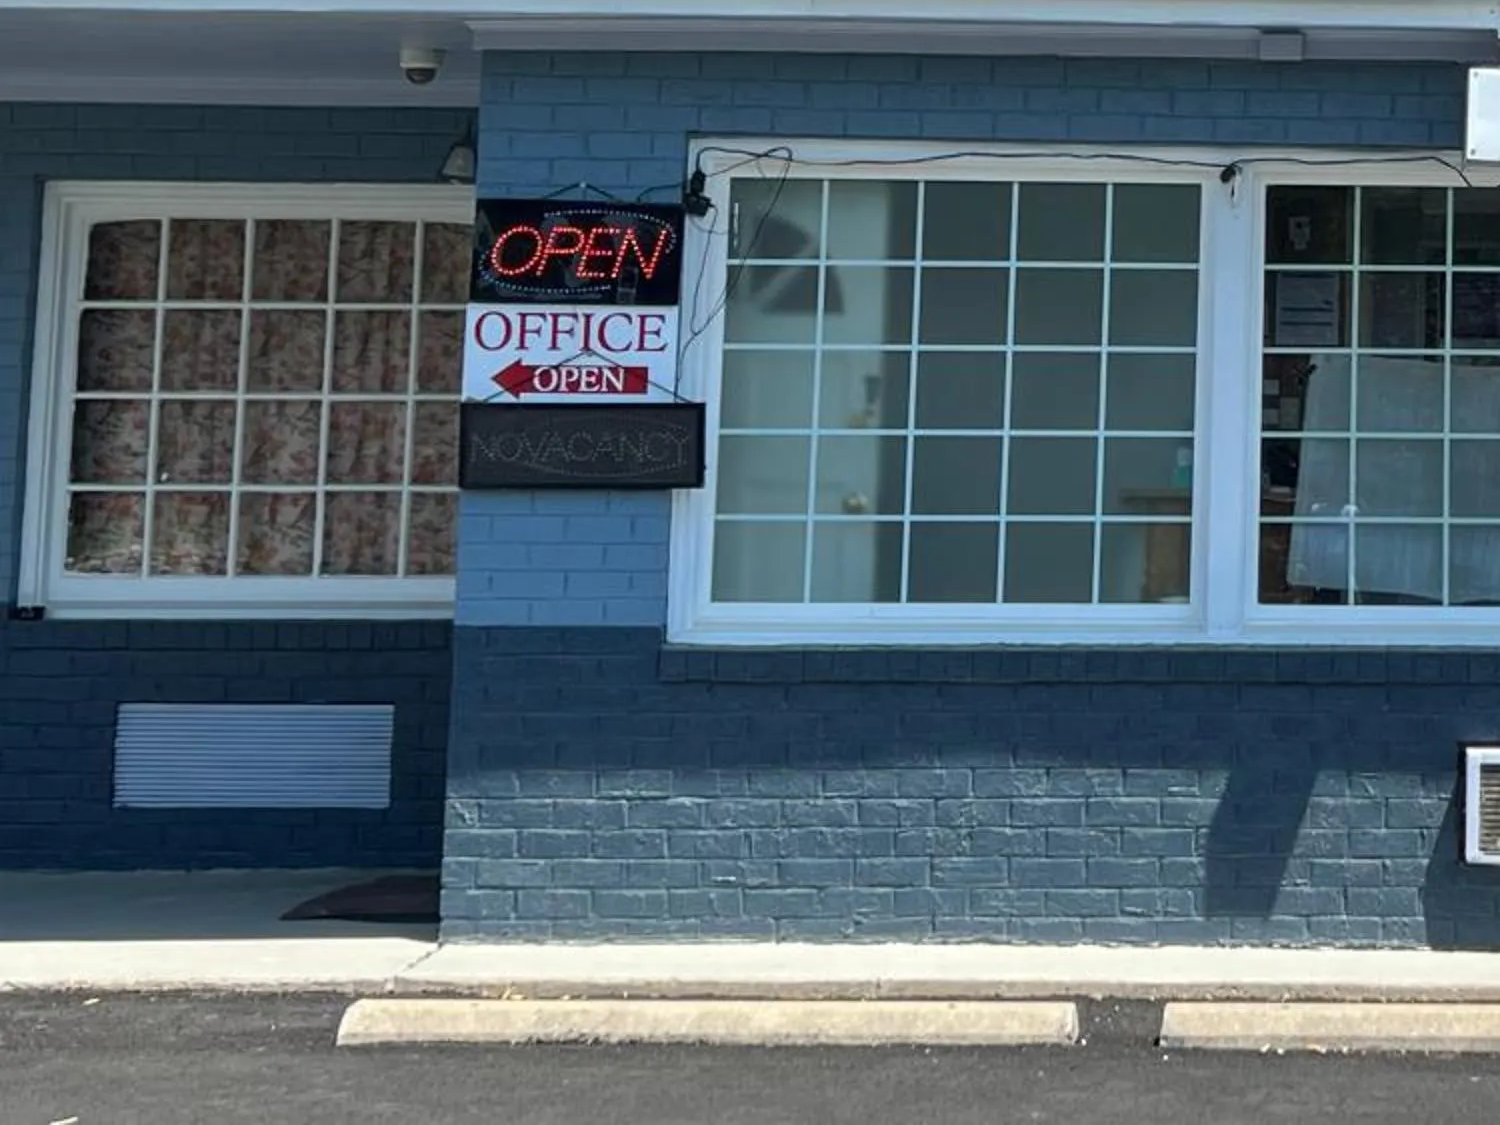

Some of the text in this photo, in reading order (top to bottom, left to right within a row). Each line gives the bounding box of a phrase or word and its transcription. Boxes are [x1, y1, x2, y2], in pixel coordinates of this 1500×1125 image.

[490, 225, 669, 279] OPEN
[473, 310, 669, 353] OFFICE
[532, 365, 626, 392] OPEN
